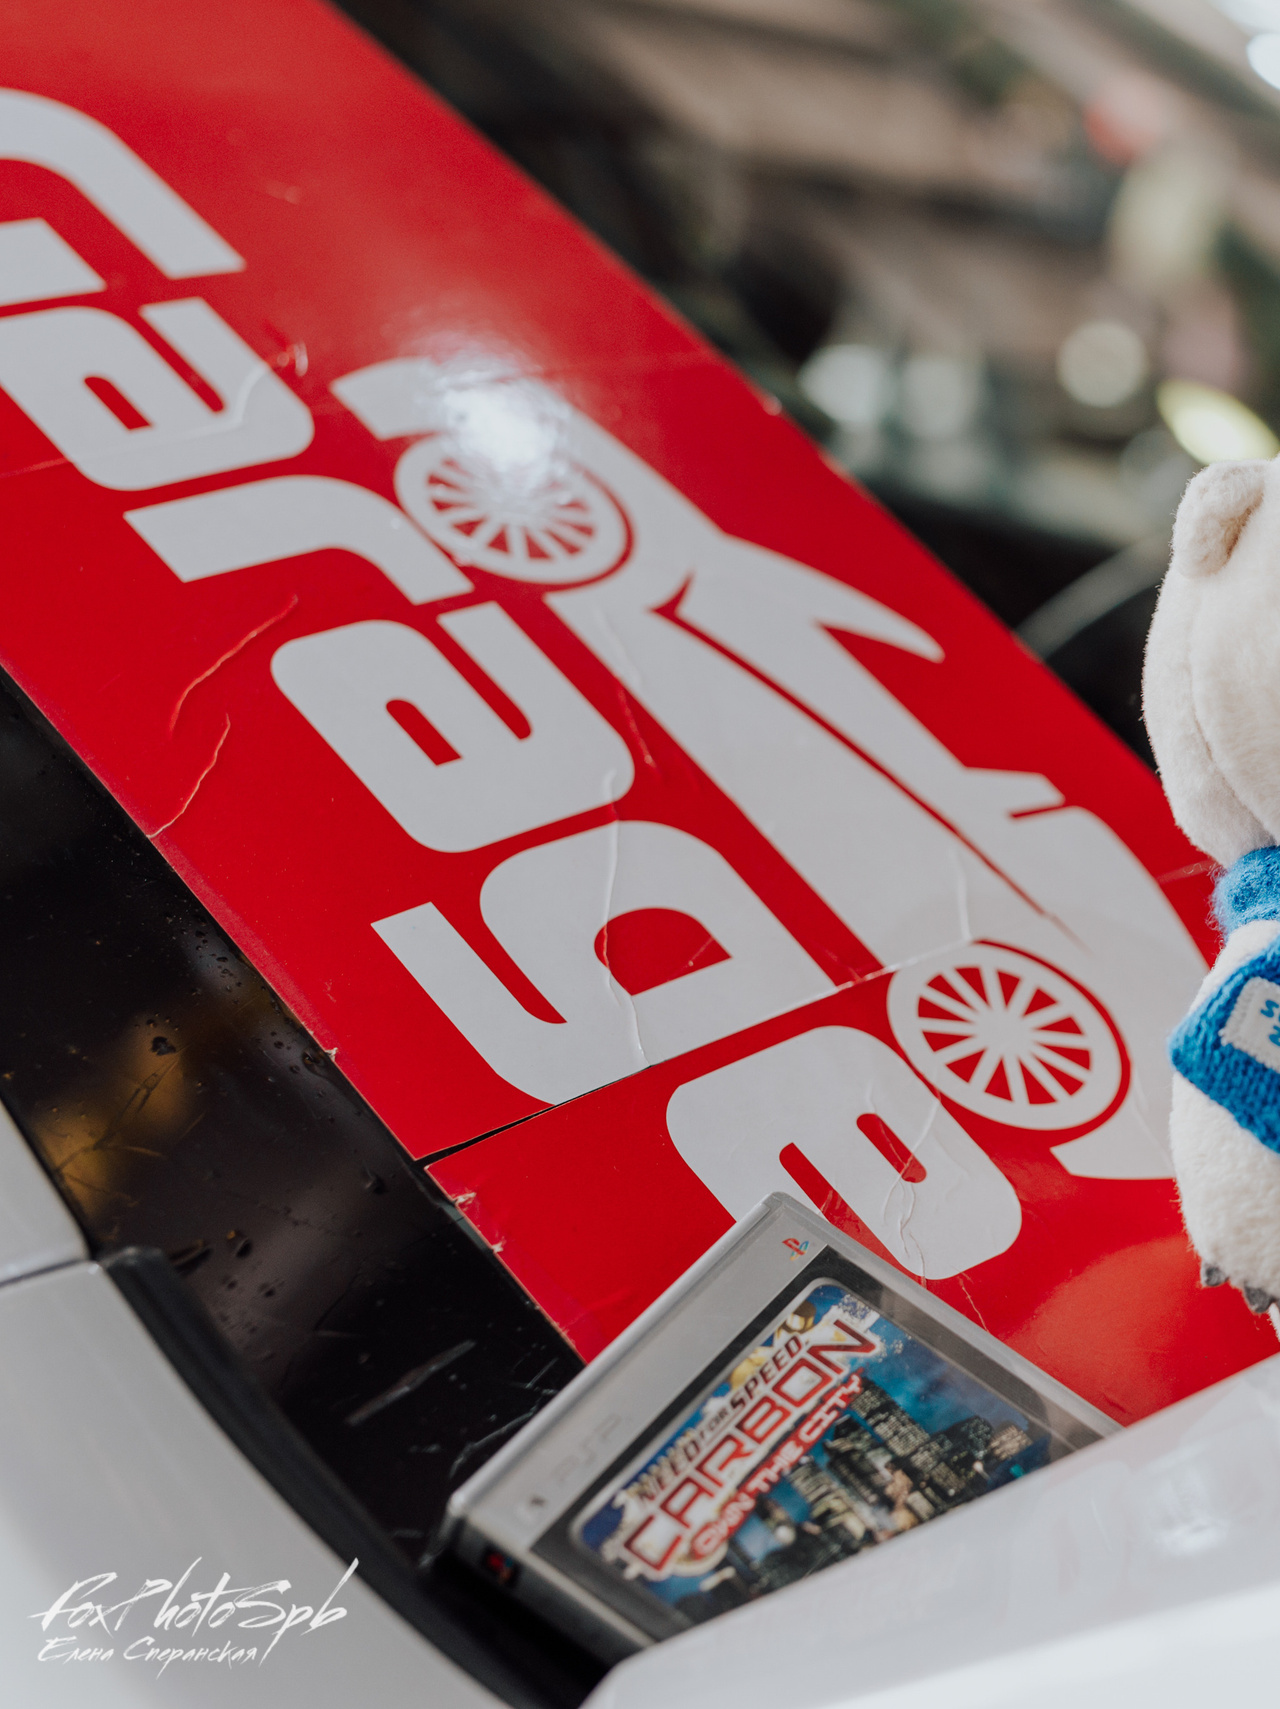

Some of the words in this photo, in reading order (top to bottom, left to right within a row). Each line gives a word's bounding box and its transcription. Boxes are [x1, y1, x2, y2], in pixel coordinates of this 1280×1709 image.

[624, 1319, 876, 1570] CARBON
[634, 1441, 700, 1504] NEED
[729, 1335, 802, 1411] SPEED
[692, 1496, 756, 1557] OWN
[750, 1442, 806, 1494] THE
[800, 1374, 862, 1444] CITY
